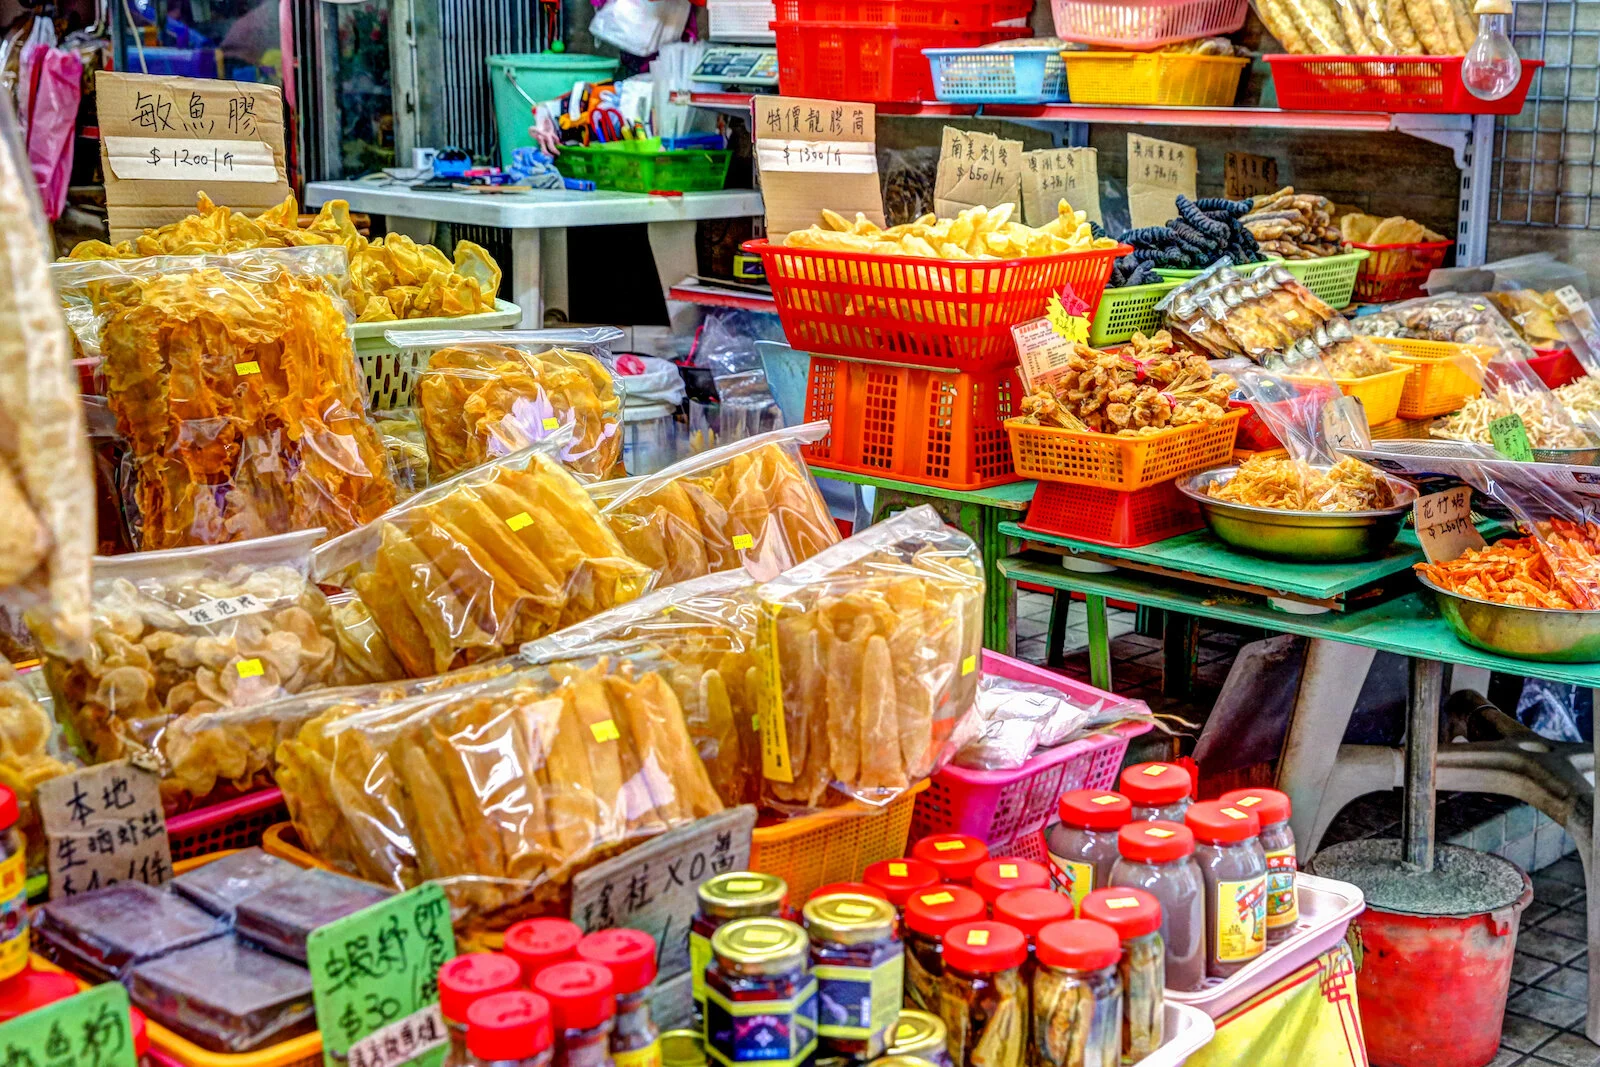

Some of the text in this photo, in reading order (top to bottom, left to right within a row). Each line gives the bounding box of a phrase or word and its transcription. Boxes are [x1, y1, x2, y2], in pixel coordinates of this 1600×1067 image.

[131, 91, 257, 137] 敏魚膠
[65, 777, 137, 827] 本地
